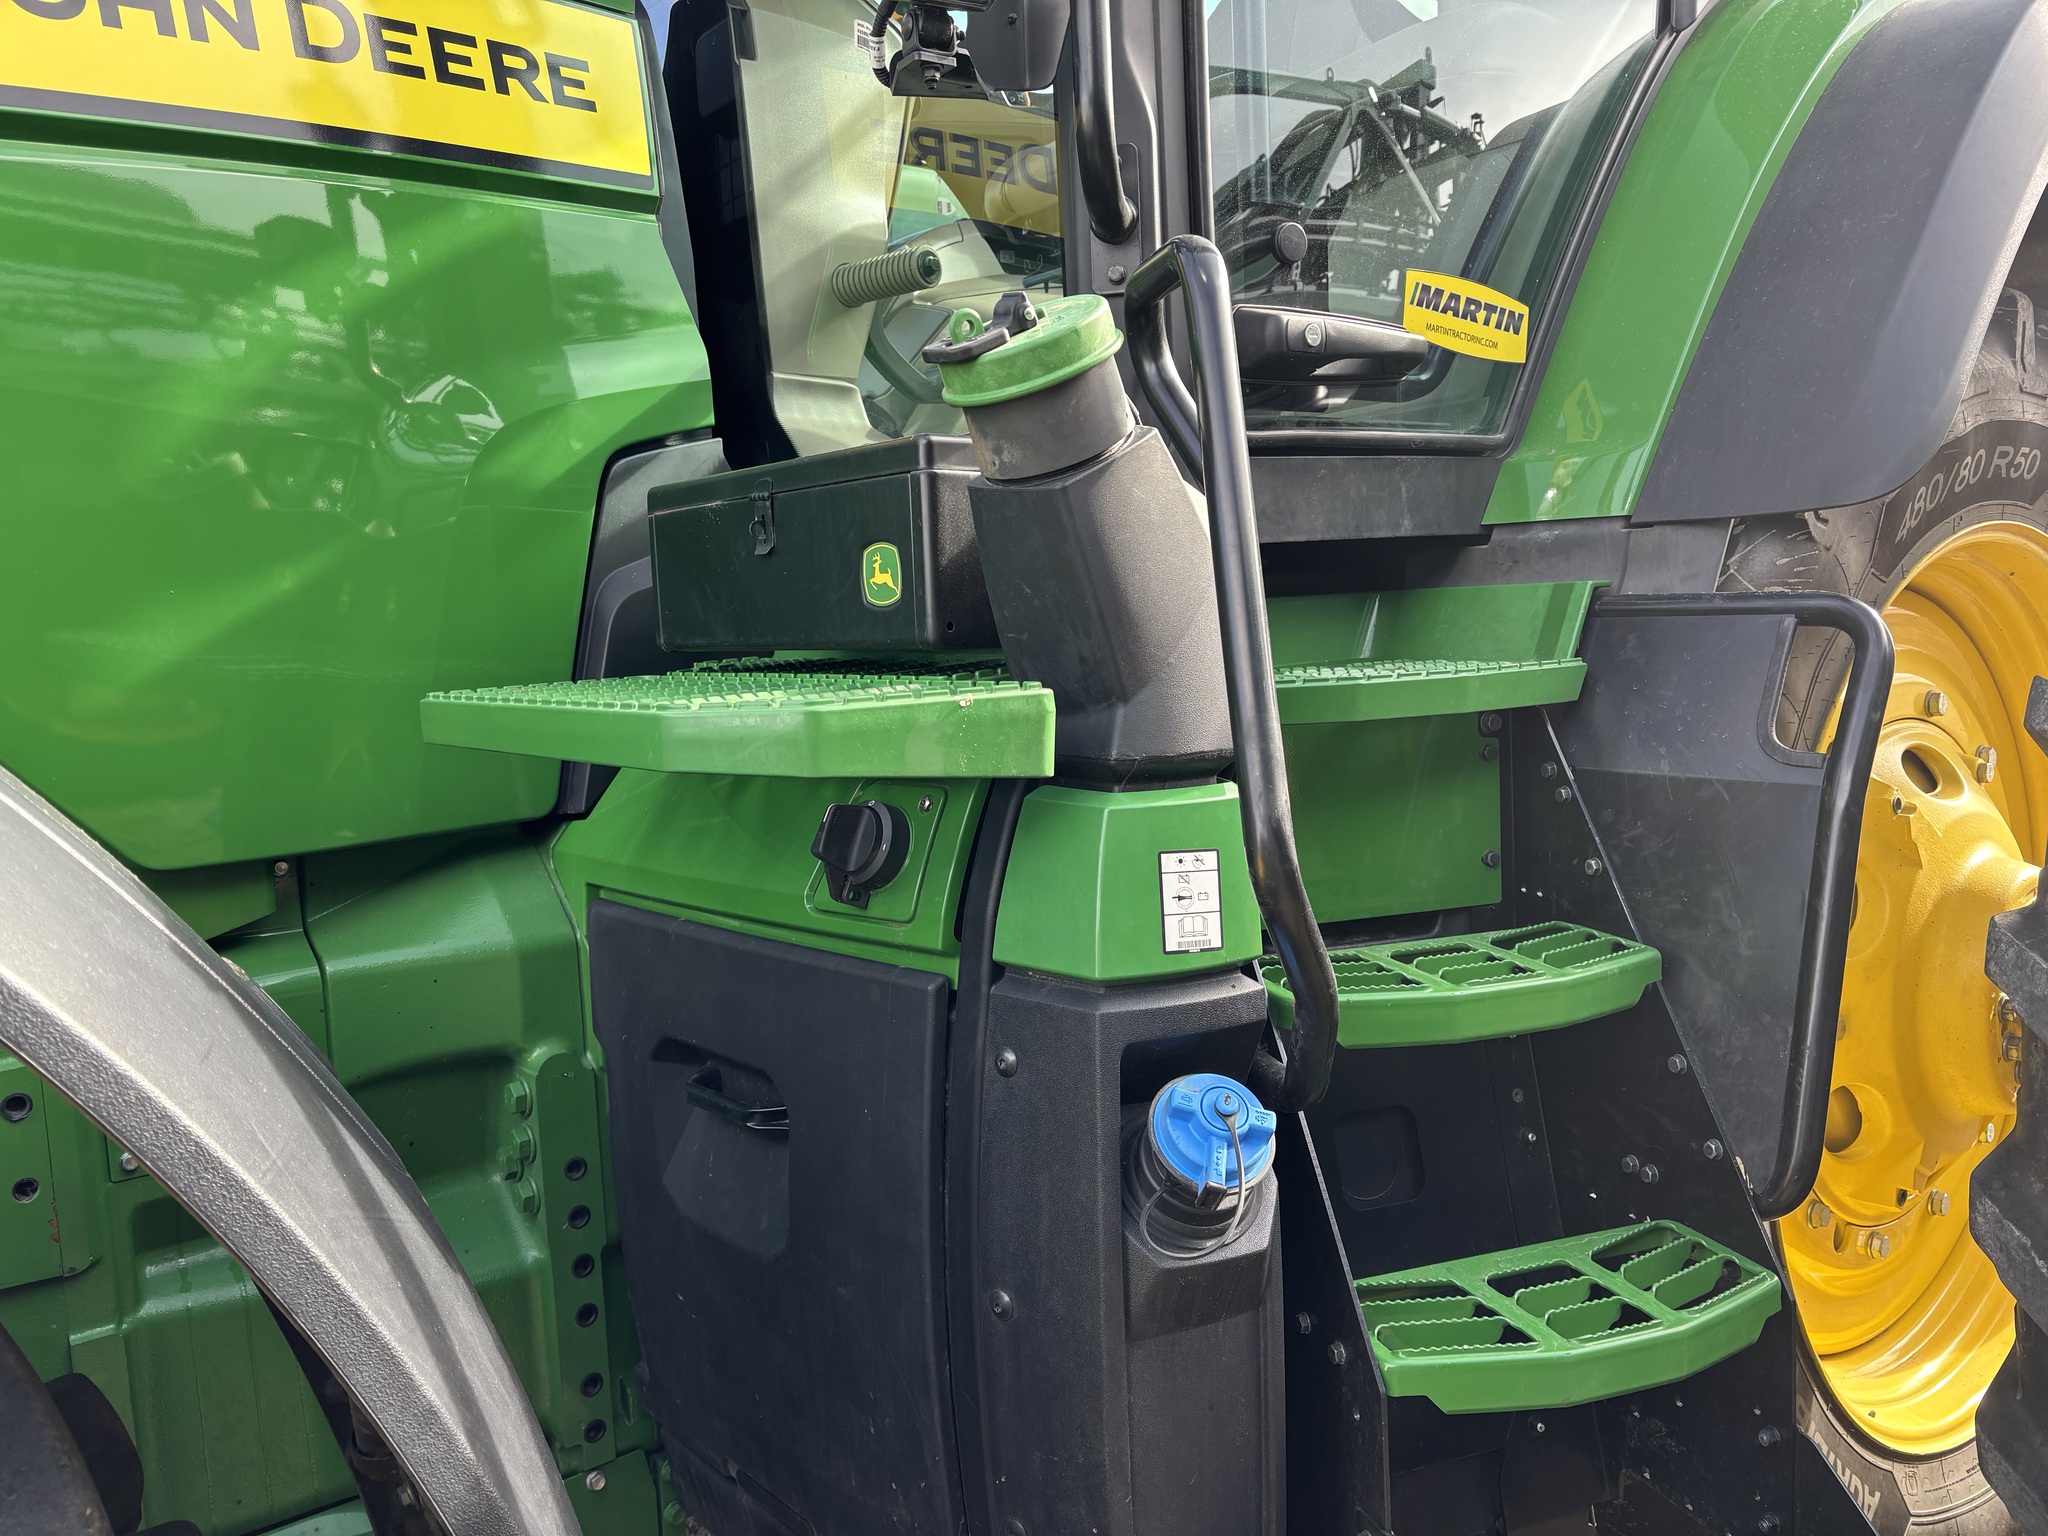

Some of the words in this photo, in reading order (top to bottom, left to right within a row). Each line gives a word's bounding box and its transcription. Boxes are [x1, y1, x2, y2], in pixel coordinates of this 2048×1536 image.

[284, 0, 598, 113] DEERE
[1415, 283, 1525, 336] MARTIN
[1425, 322, 1499, 350] MARTINTRACTORINC.COM
[1894, 448, 1986, 545] 480/80
[1987, 445, 2042, 480] R50
